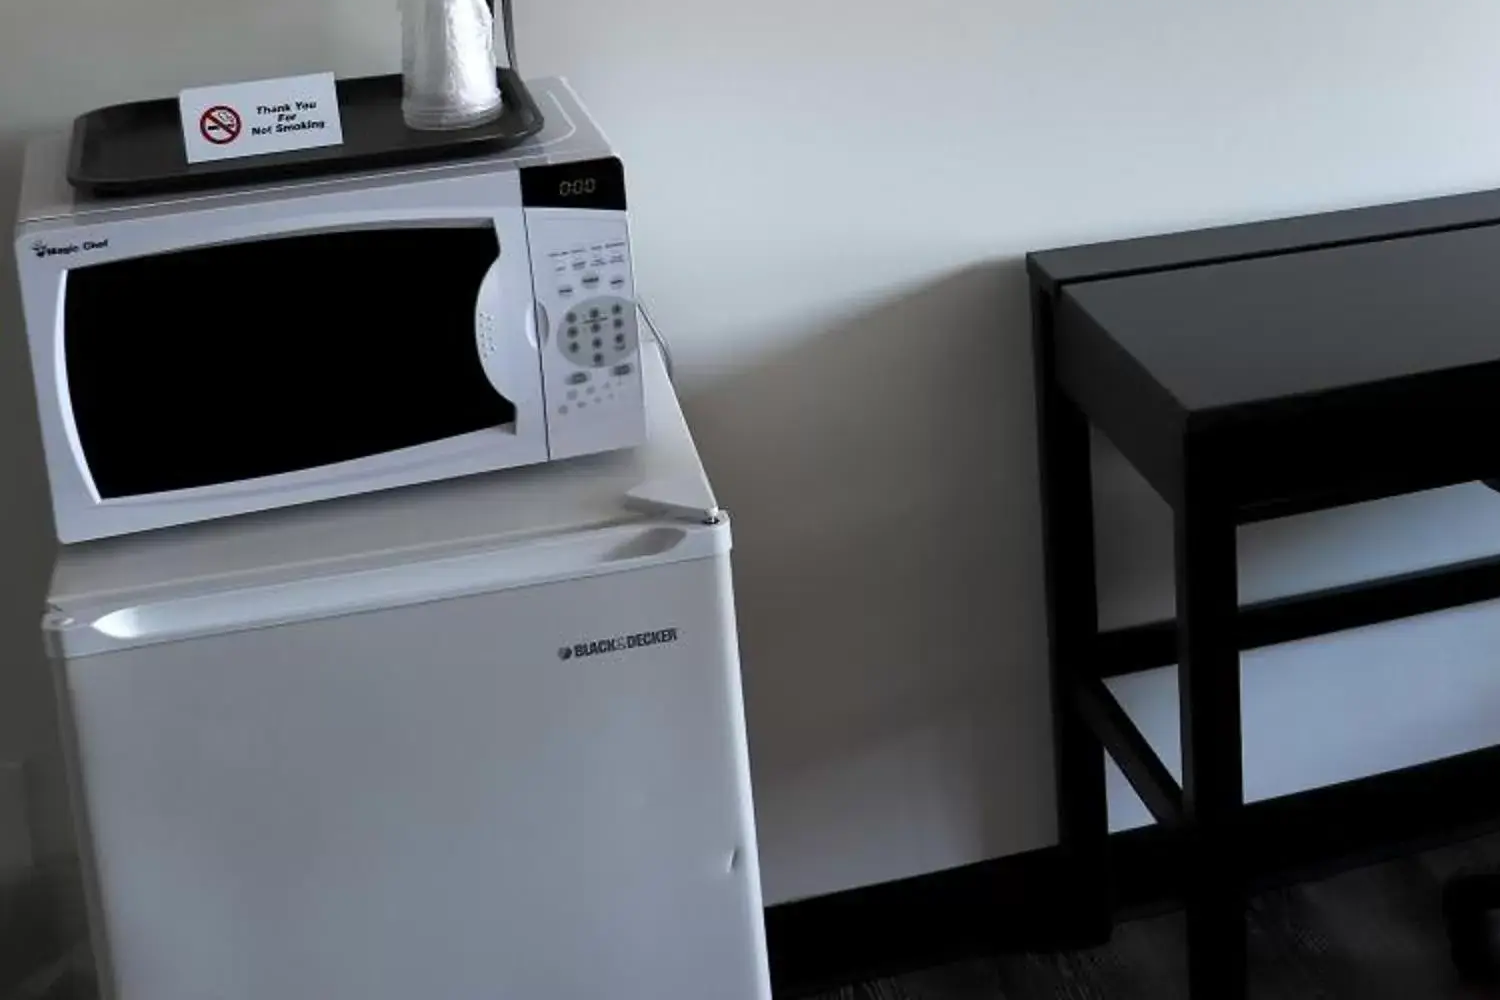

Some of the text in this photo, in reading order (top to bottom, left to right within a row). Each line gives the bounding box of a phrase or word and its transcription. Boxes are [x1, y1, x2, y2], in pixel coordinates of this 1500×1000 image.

[256, 101, 317, 114] Thank You
[277, 113, 297, 122] For
[251, 120, 324, 136] Not Smoking
[83, 239, 108, 251] Chef
